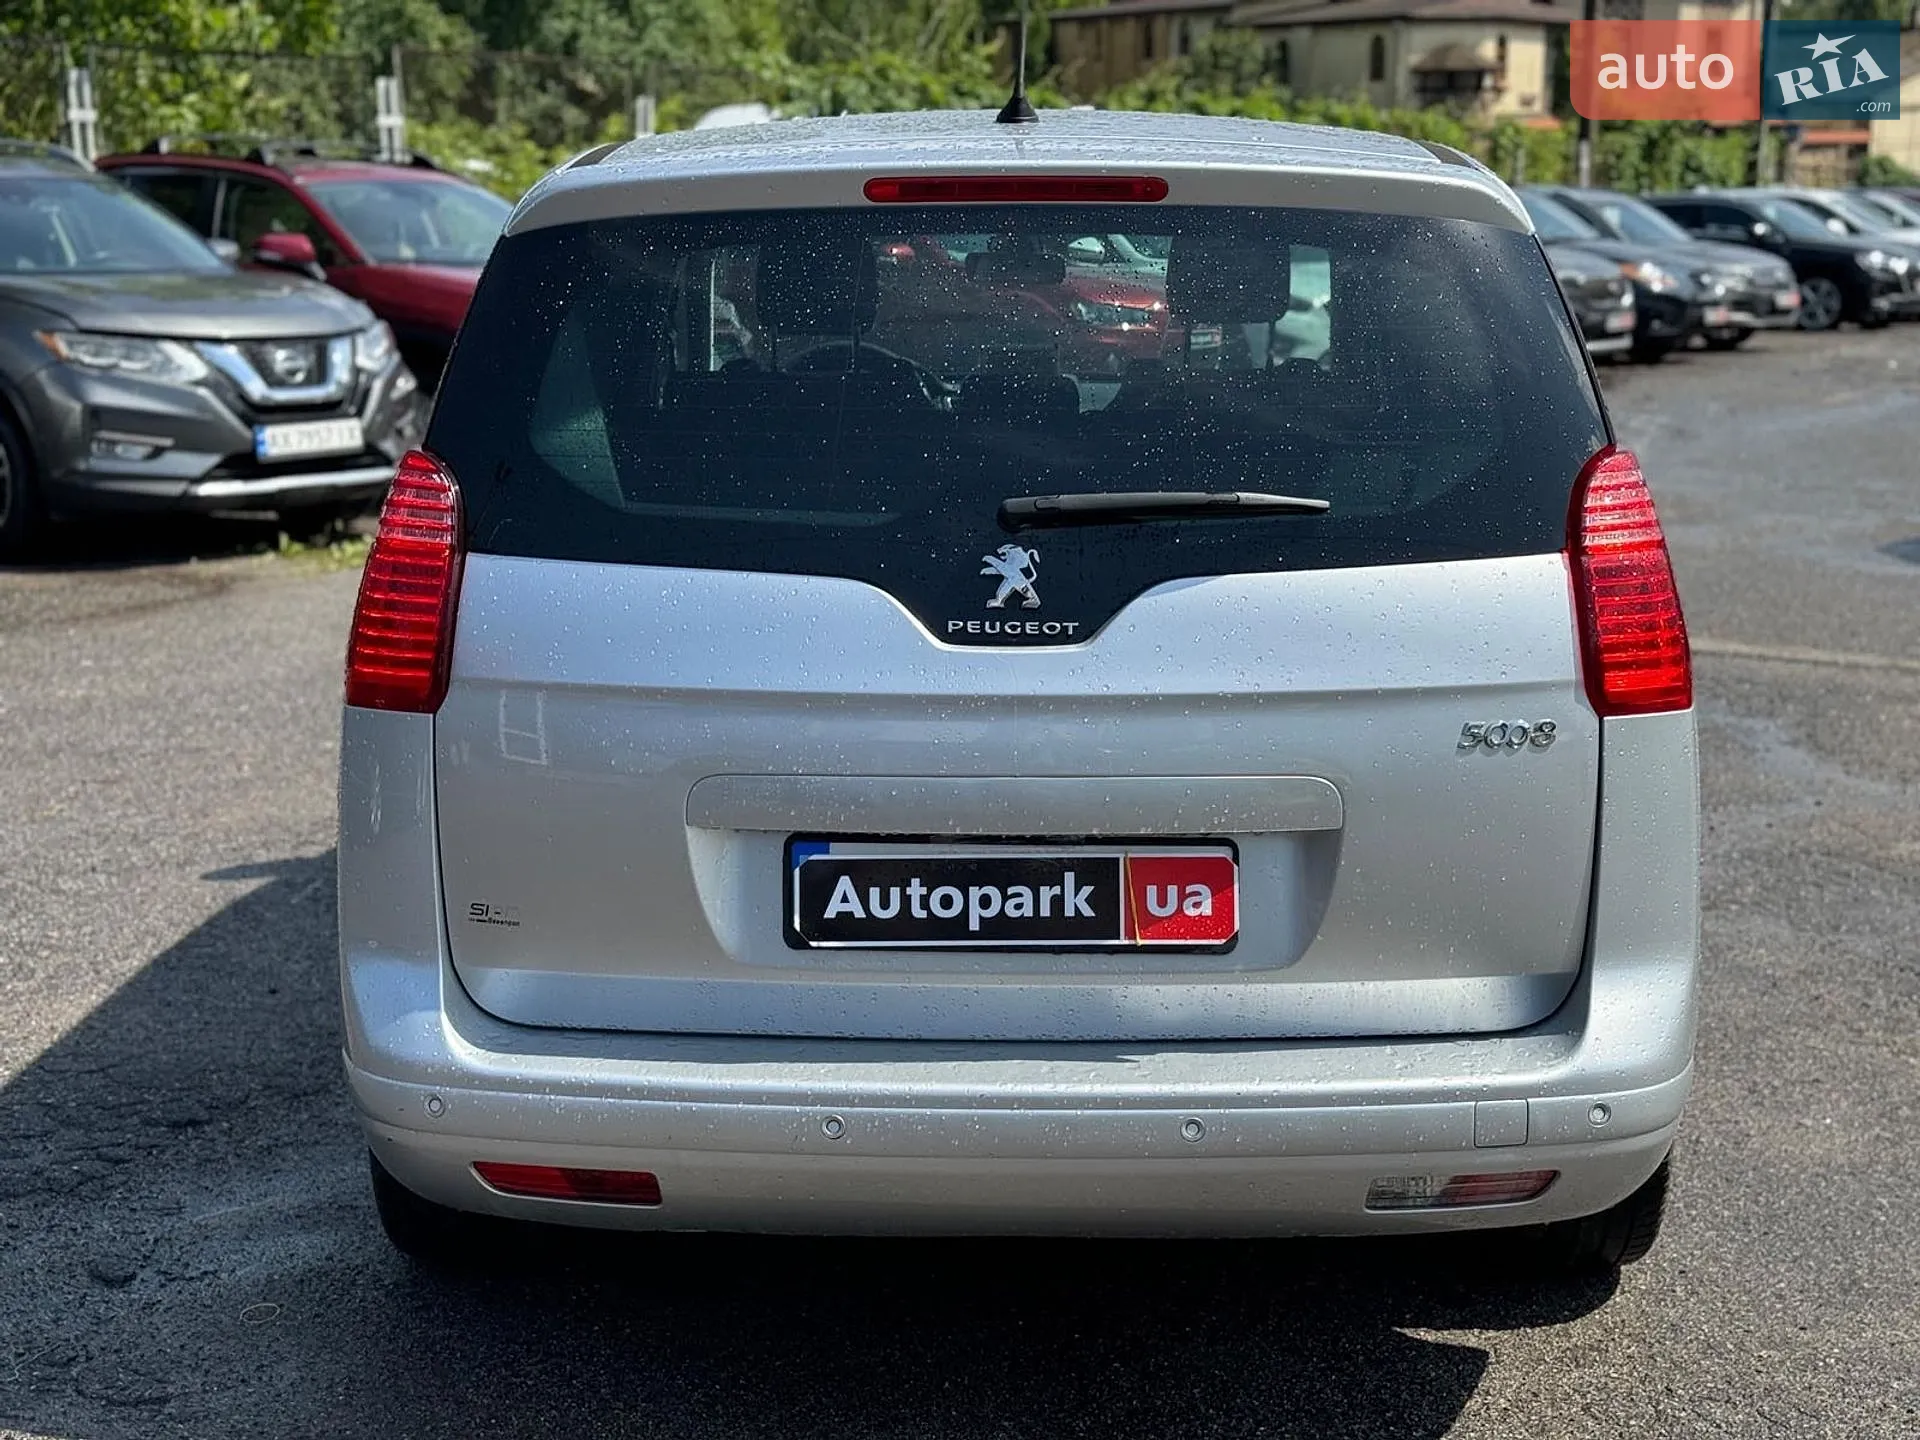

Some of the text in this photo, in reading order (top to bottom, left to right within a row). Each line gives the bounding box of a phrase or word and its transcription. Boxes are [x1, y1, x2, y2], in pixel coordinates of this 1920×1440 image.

[947, 620, 1080, 636] PEUGEOT
[1456, 718, 1557, 750] 5008
[823, 871, 1213, 931] Autopark ua
